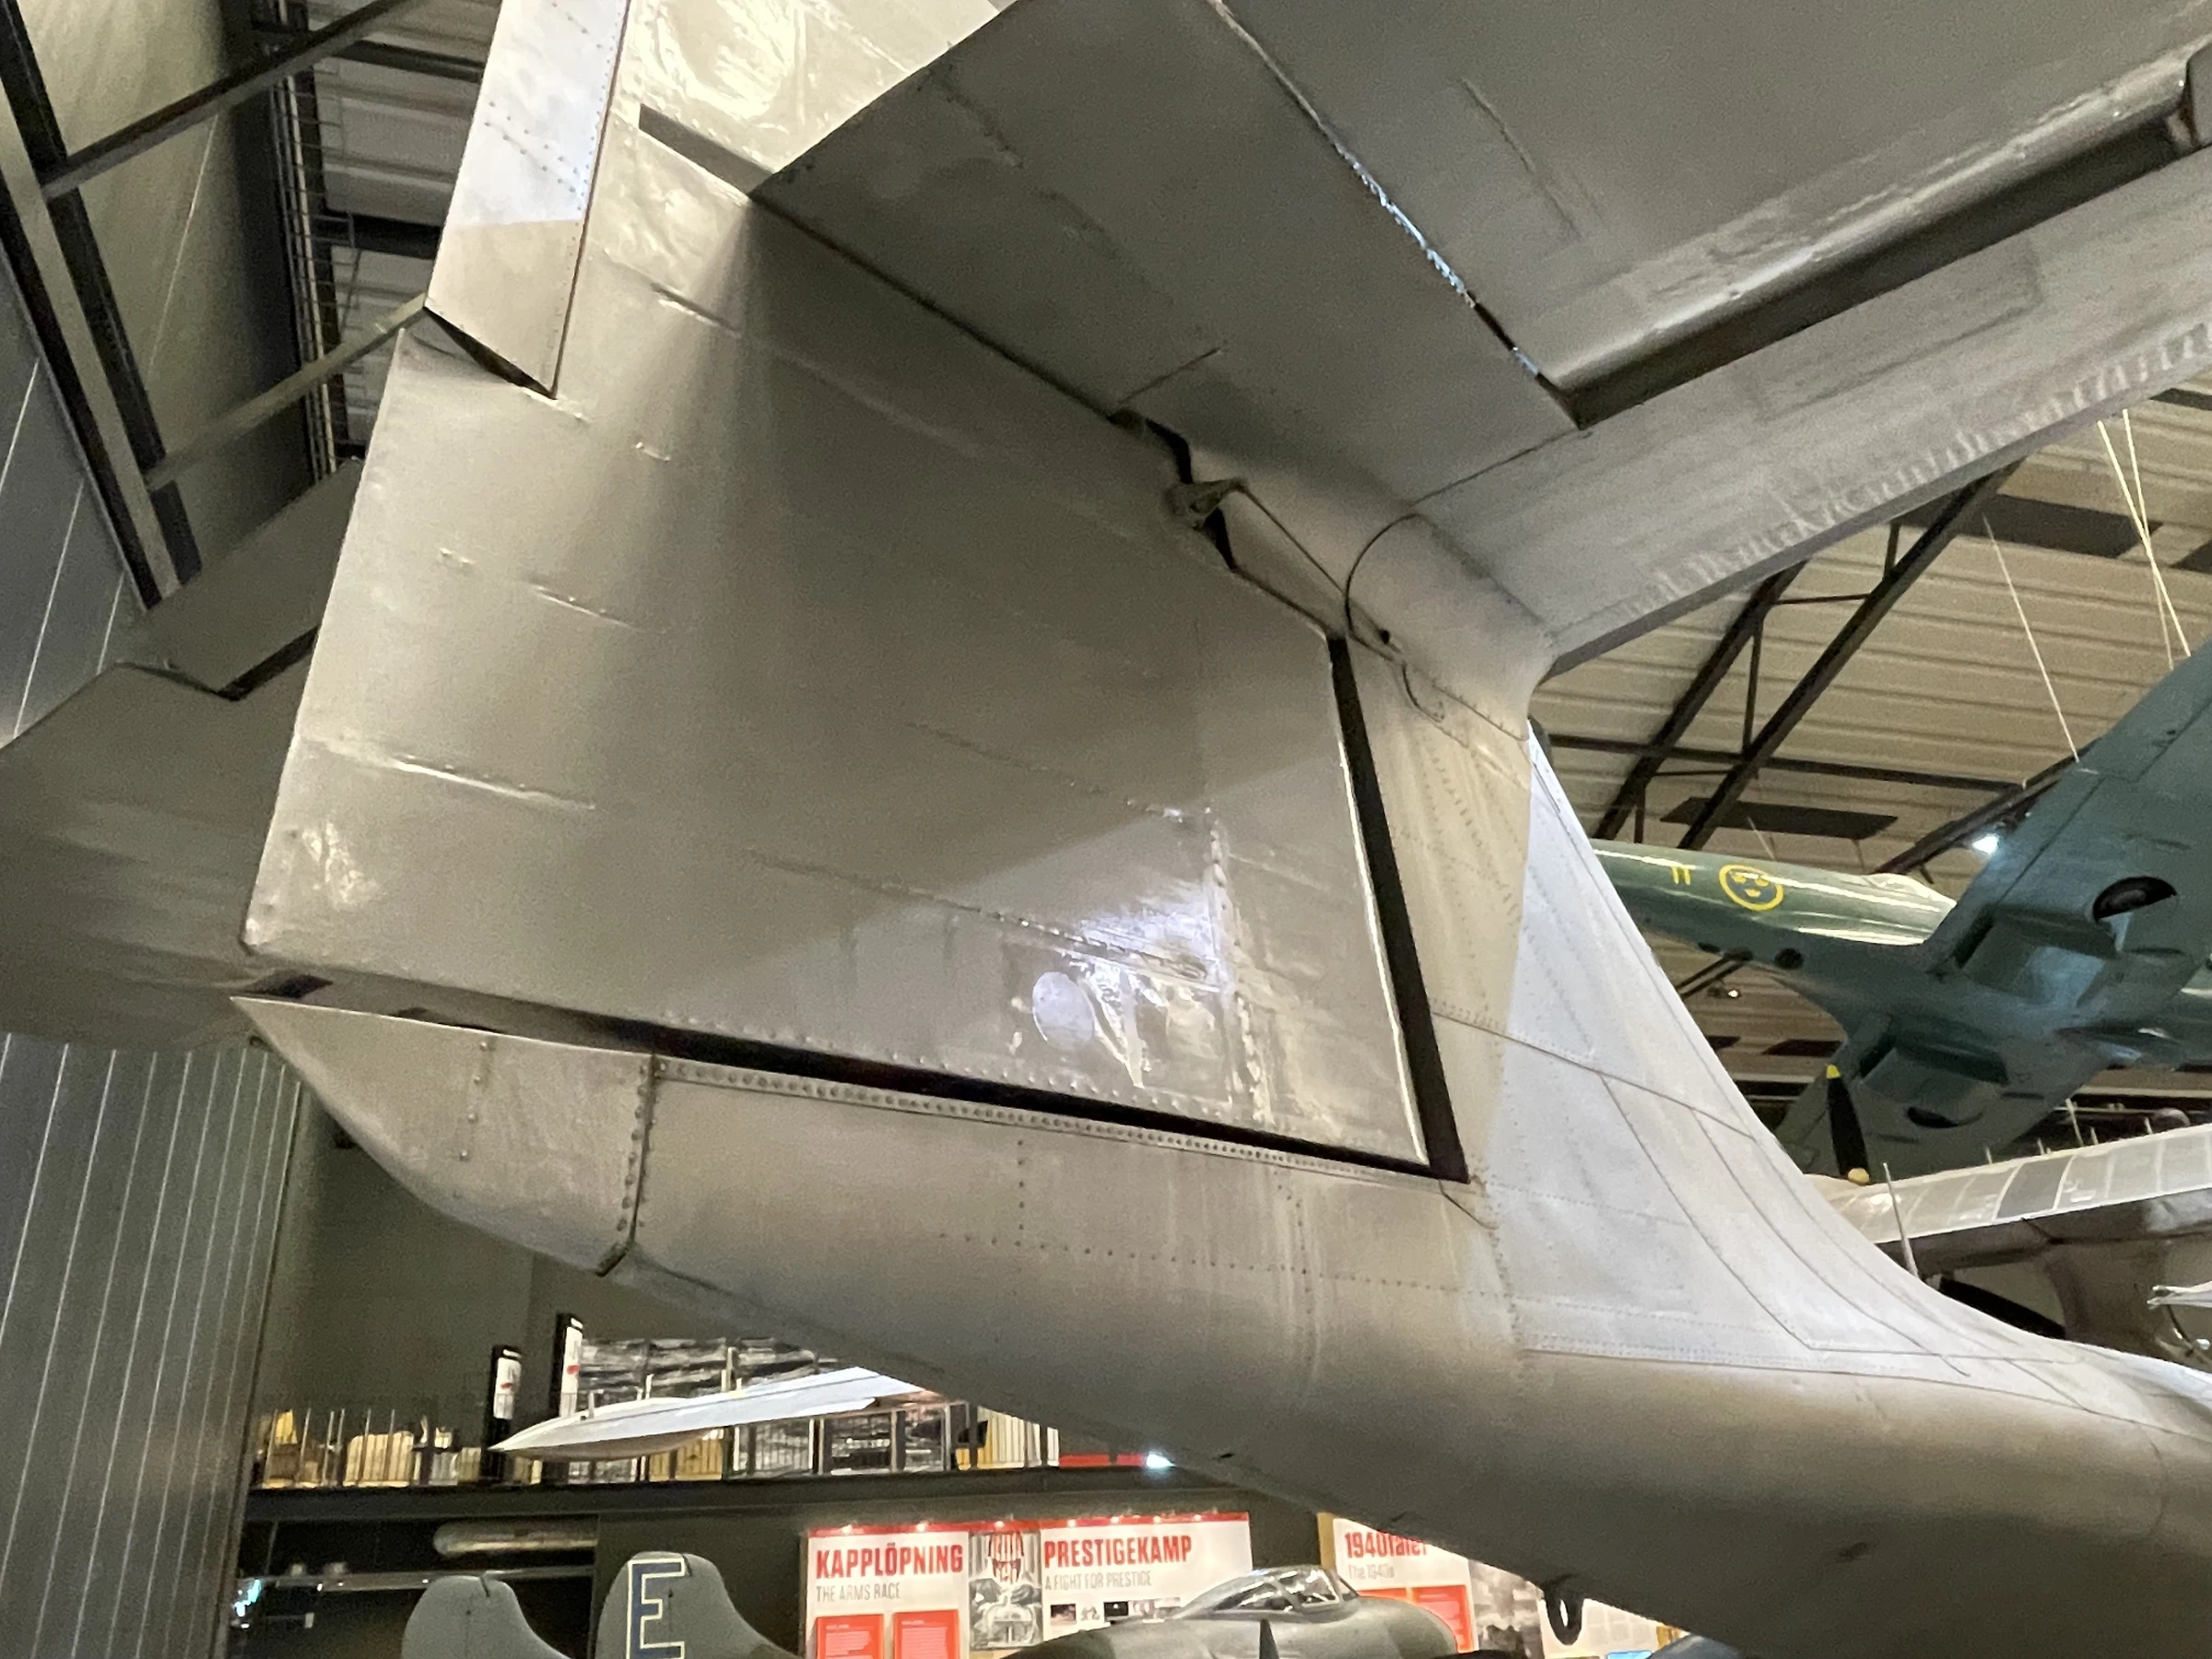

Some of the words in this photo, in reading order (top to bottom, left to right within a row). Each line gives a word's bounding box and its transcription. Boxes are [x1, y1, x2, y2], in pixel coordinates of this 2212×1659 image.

[816, 1542, 964, 1580] KAPPLÖPNING
[1043, 1535, 1193, 1570] PRESTIGEKAMP
[816, 1584, 836, 1603] THE
[839, 1583, 871, 1602] ARMS
[874, 1582, 901, 1600] RACE
[1044, 1575, 1053, 1591] A
[1053, 1573, 1082, 1591] FIGHT
[1085, 1572, 1104, 1590] FOR
[1106, 1570, 1152, 1588] PRESTIGE
[626, 1558, 686, 1659] E
